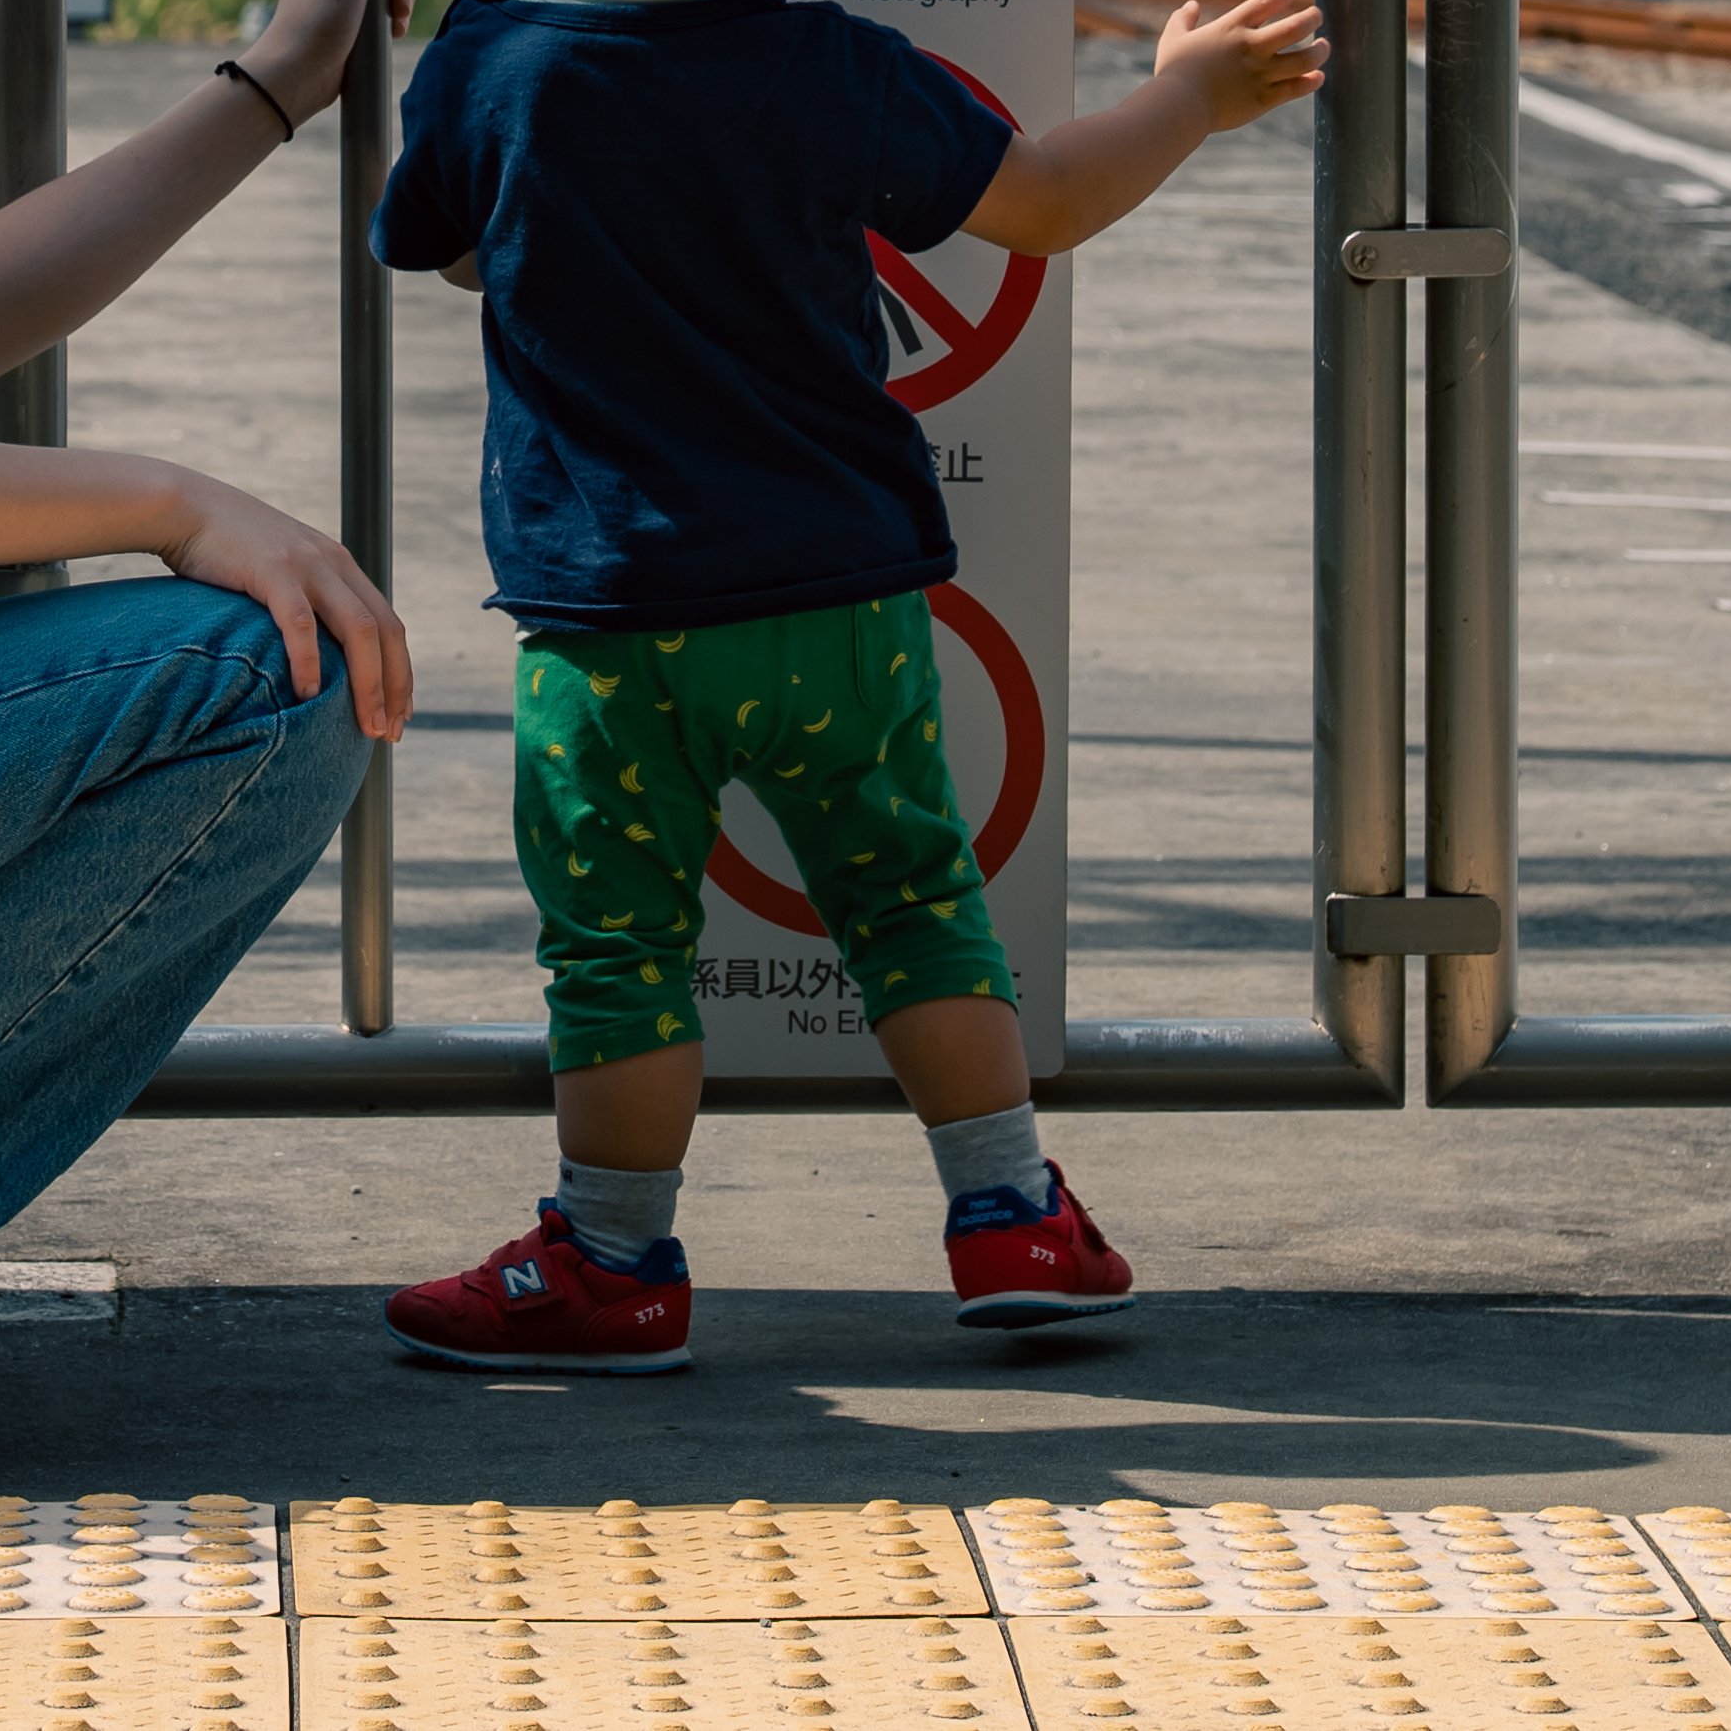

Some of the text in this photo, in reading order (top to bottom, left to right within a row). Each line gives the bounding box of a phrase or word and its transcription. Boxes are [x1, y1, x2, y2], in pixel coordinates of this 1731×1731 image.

[788, 1010, 827, 1034] No
[969, 1198, 998, 1212] new
[1029, 1245, 1056, 1265] 373
[500, 1257, 549, 1299] N
[634, 1302, 665, 1325] 373
